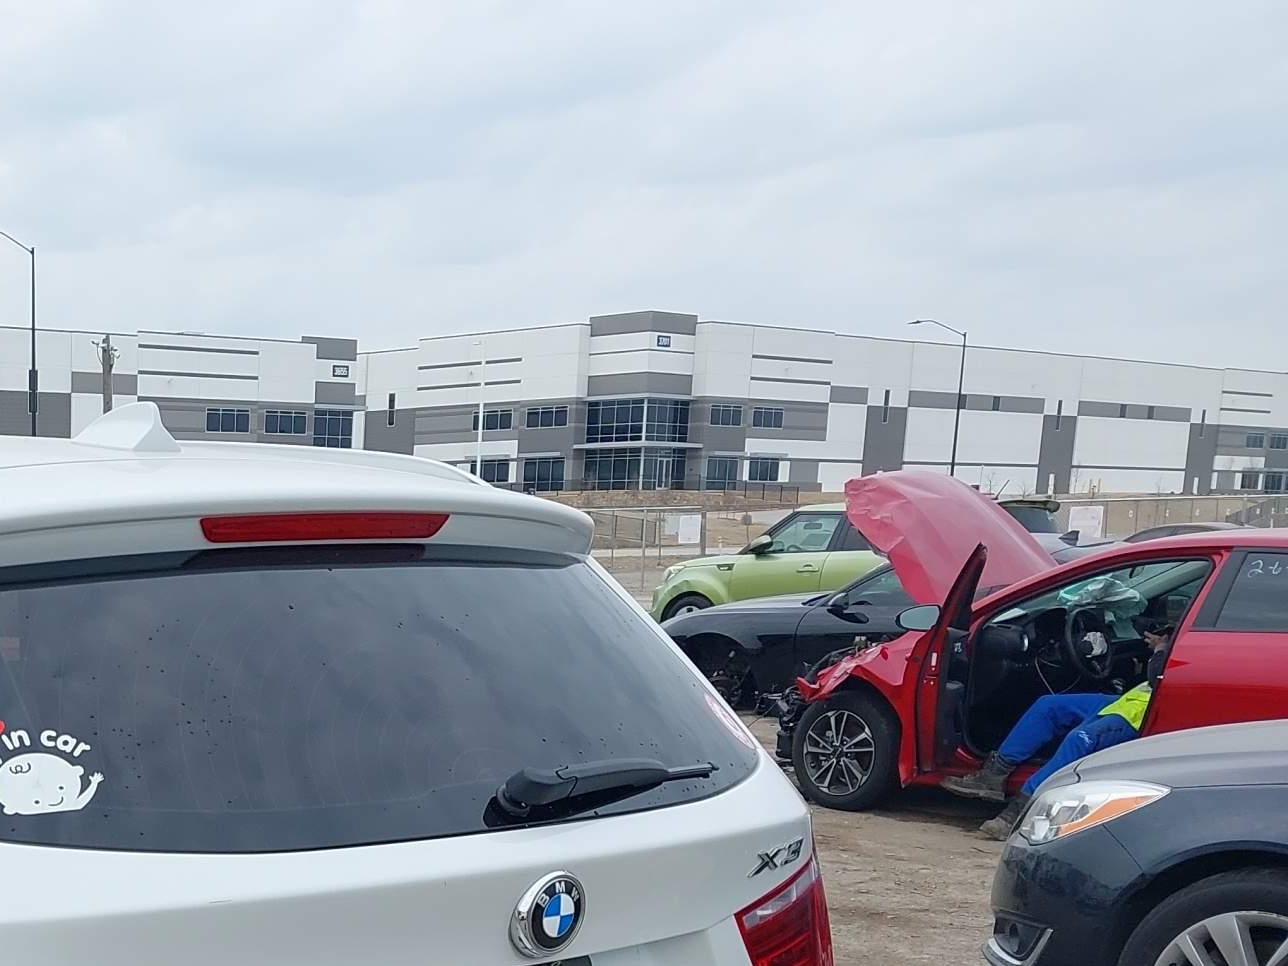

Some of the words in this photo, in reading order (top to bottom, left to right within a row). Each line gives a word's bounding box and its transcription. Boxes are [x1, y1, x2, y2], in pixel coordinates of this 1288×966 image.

[1, 729, 31, 750] in
[40, 729, 91, 758] car
[746, 836, 805, 879] X3
[537, 881, 580, 908] BMW
